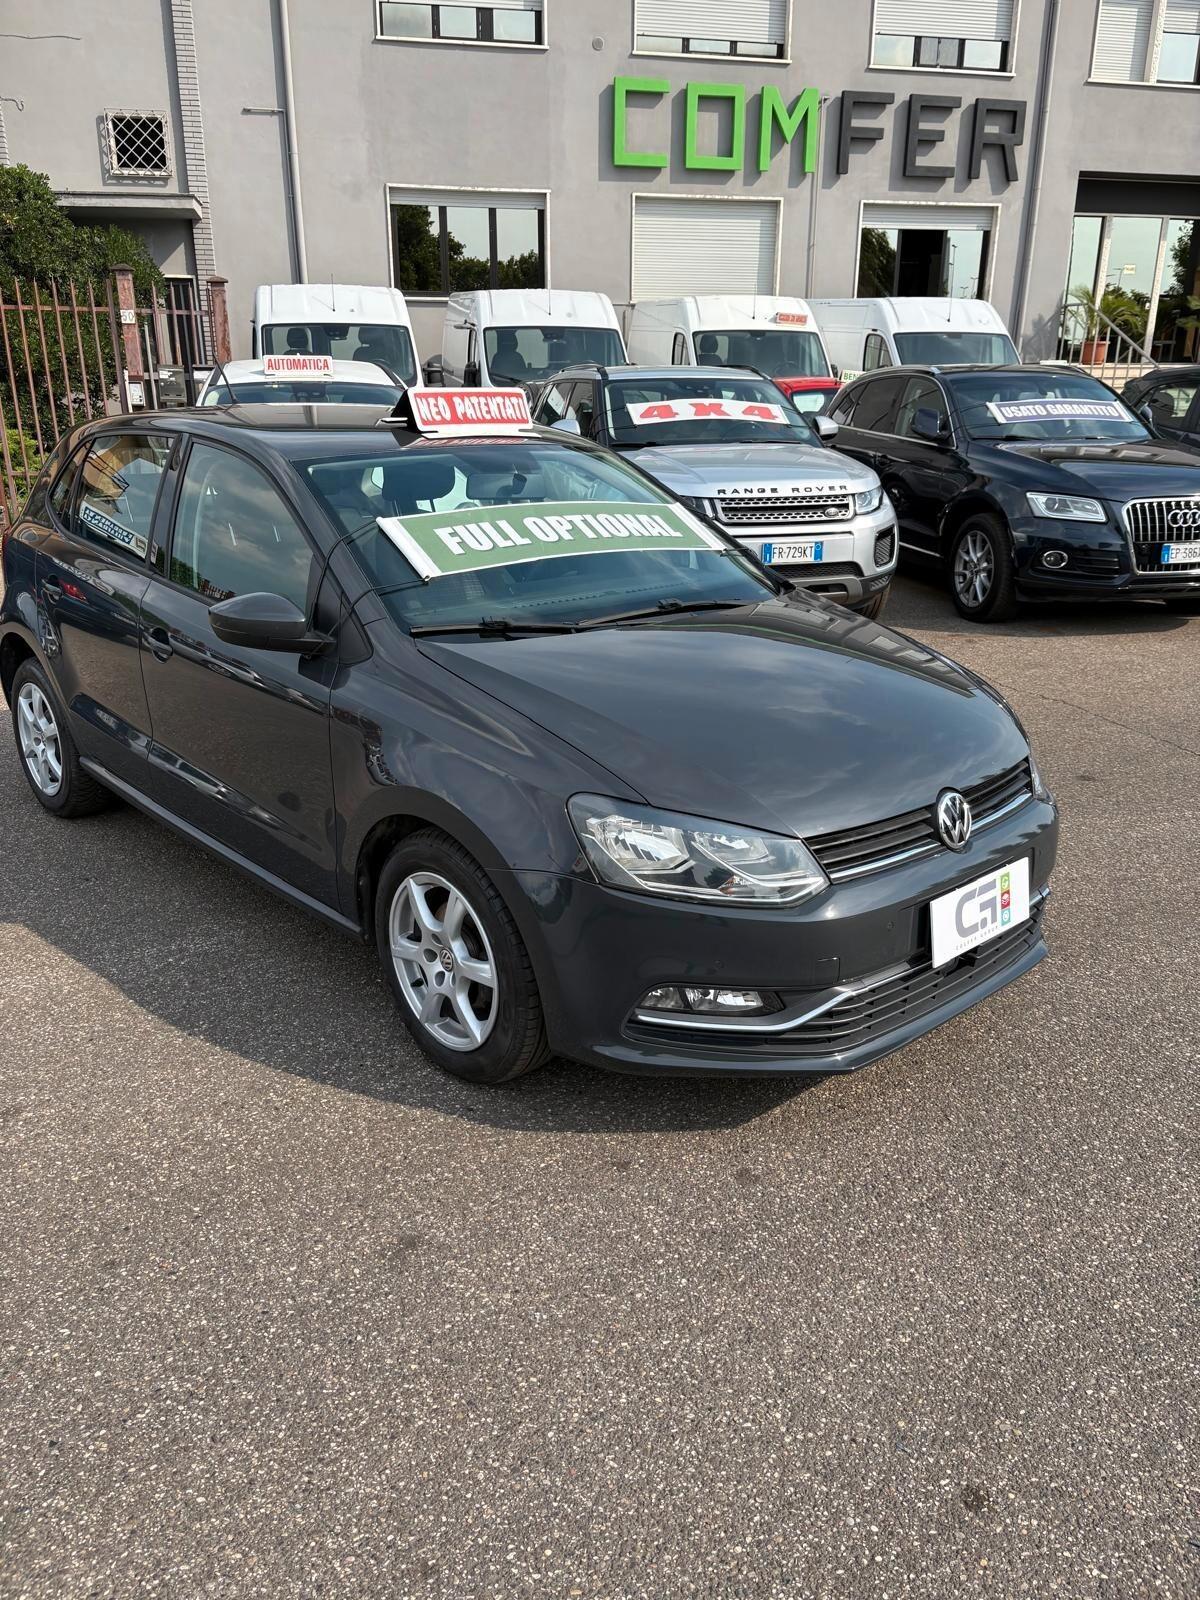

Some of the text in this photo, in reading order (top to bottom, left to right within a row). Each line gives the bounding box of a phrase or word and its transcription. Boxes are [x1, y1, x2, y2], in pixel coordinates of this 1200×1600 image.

[613, 76, 1027, 182] COMFER
[267, 358, 330, 371] AUTOMATICA
[416, 396, 527, 421] NEO PATENTATI
[1000, 403, 1119, 418] USATO GARANTITO
[717, 485, 848, 495] RANGE ROVER
[433, 513, 683, 556] FULL OPTIONAL
